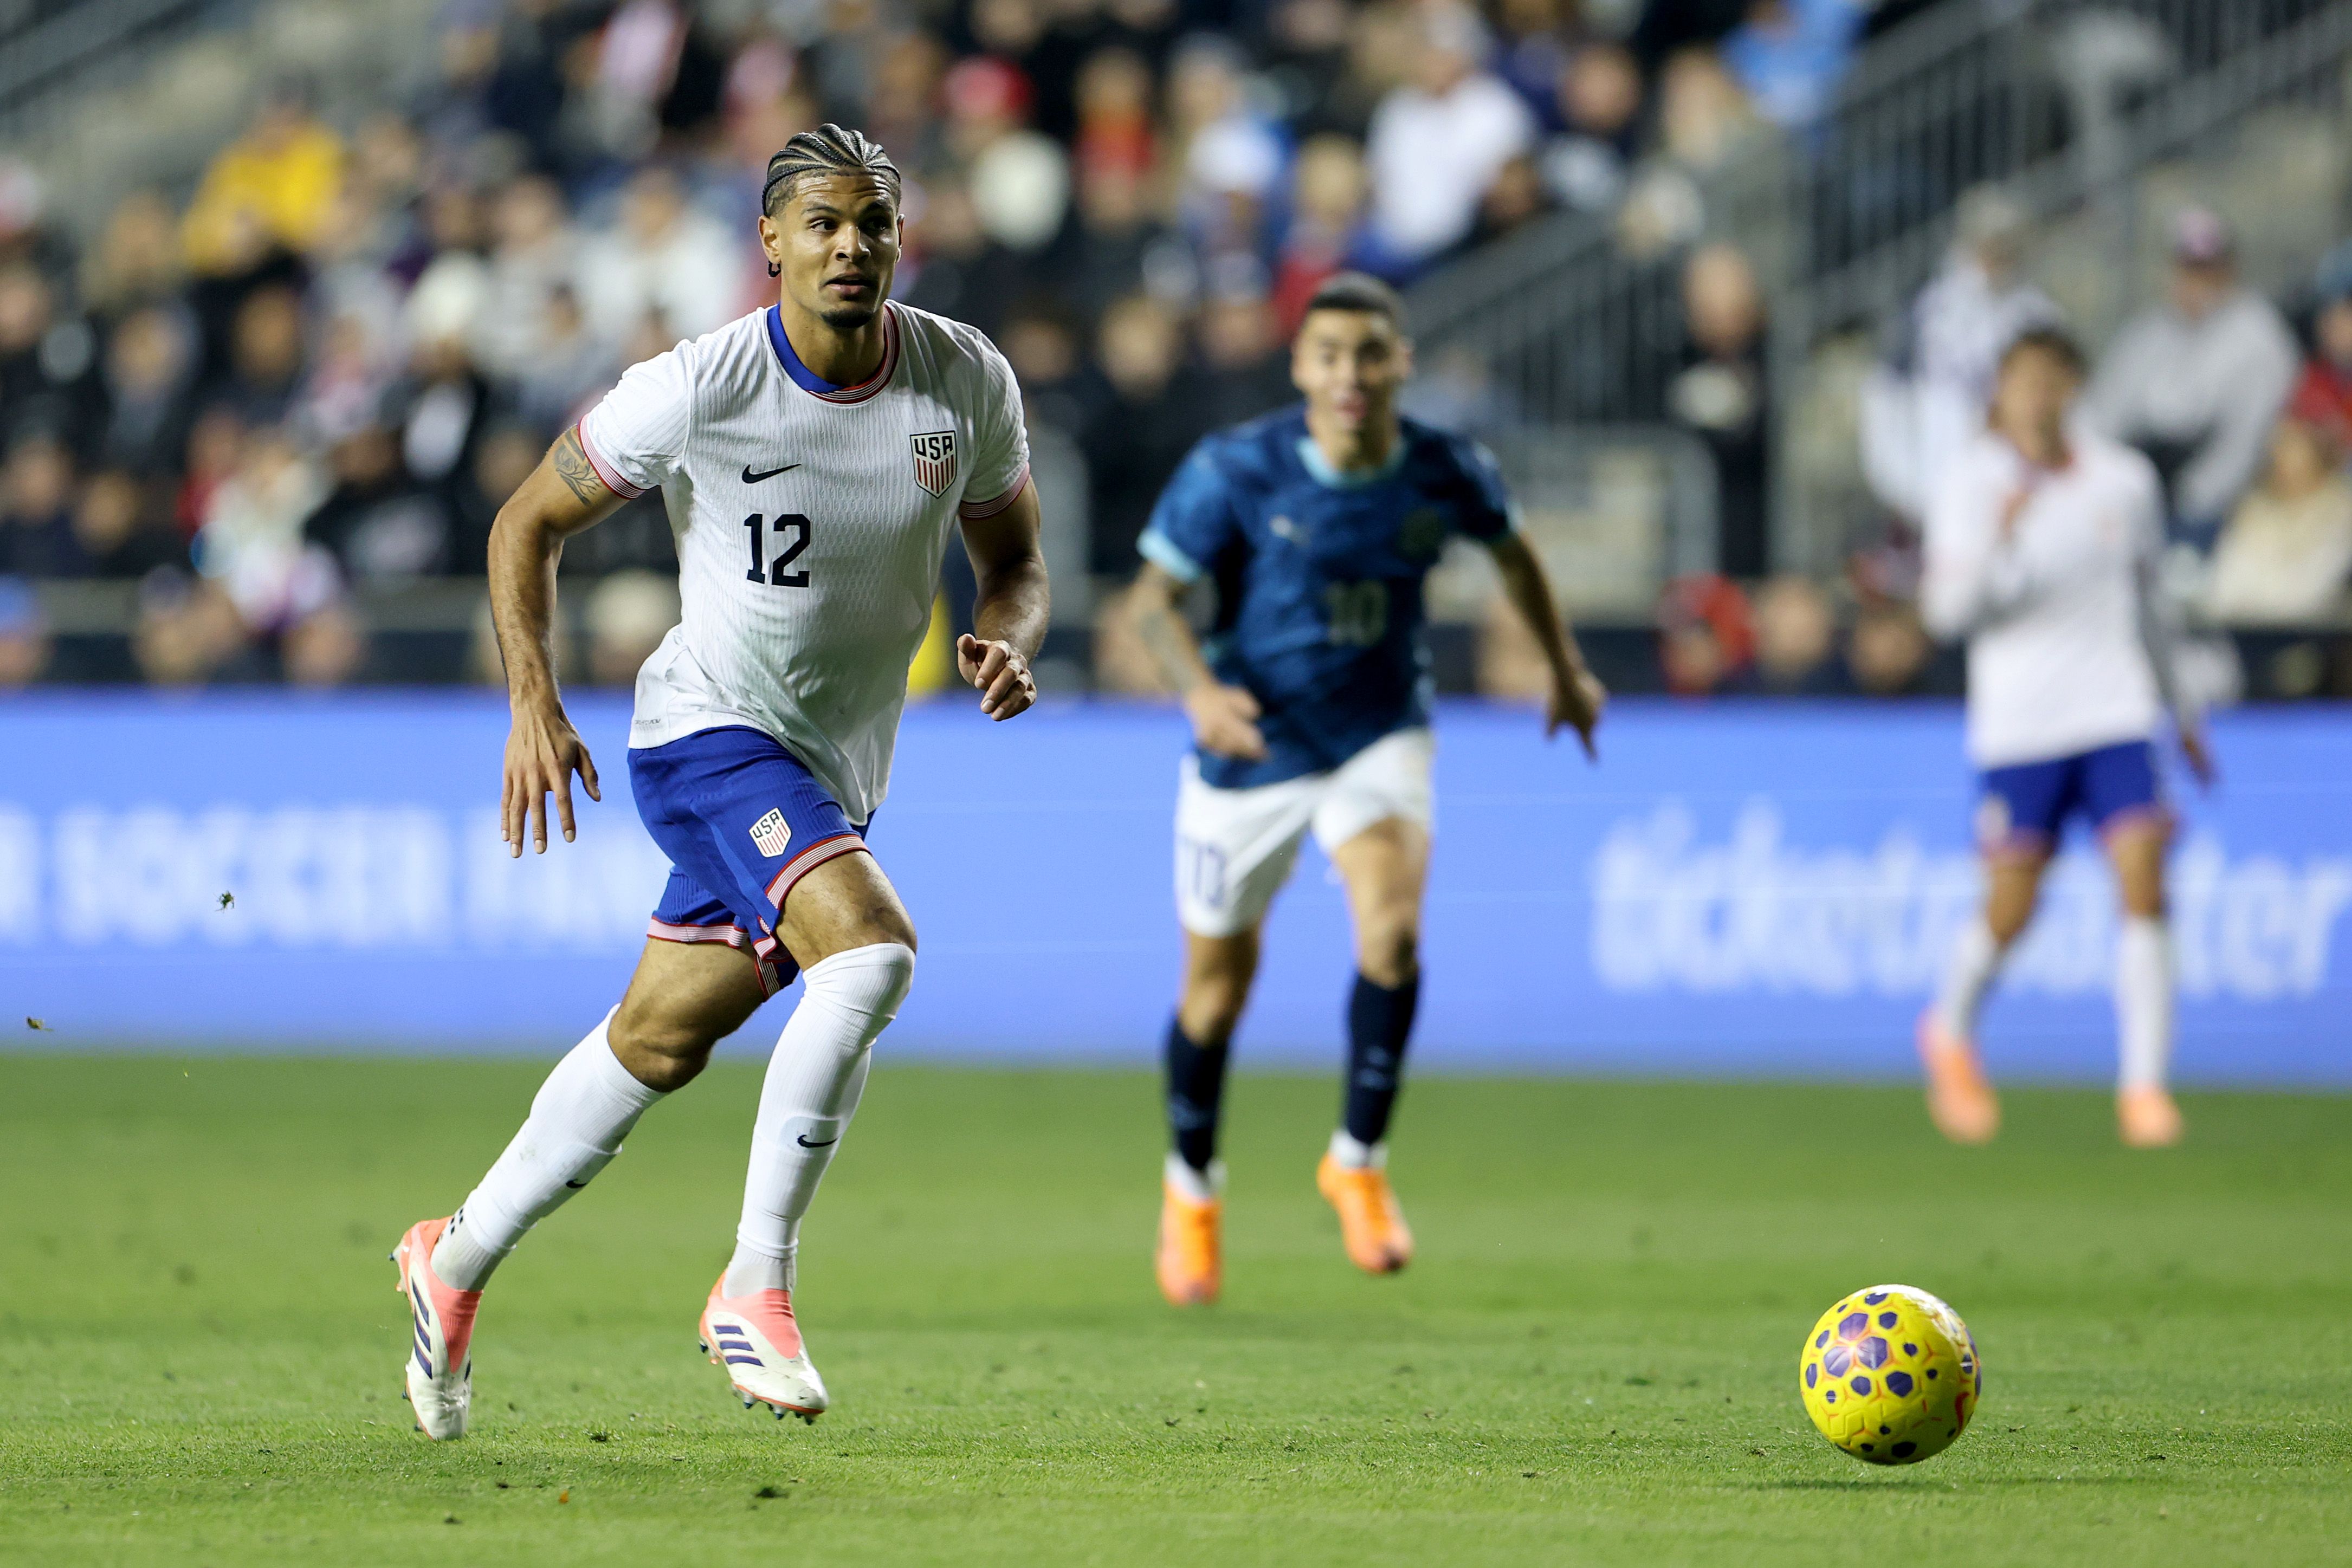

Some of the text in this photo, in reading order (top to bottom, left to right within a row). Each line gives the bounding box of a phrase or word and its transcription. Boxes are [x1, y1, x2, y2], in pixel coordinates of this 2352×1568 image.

[914, 436, 953, 461] USA
[744, 513, 811, 587] 12
[1324, 579, 1390, 647] 10
[752, 811, 780, 839] USA
[1591, 798, 2352, 997] ticketater
